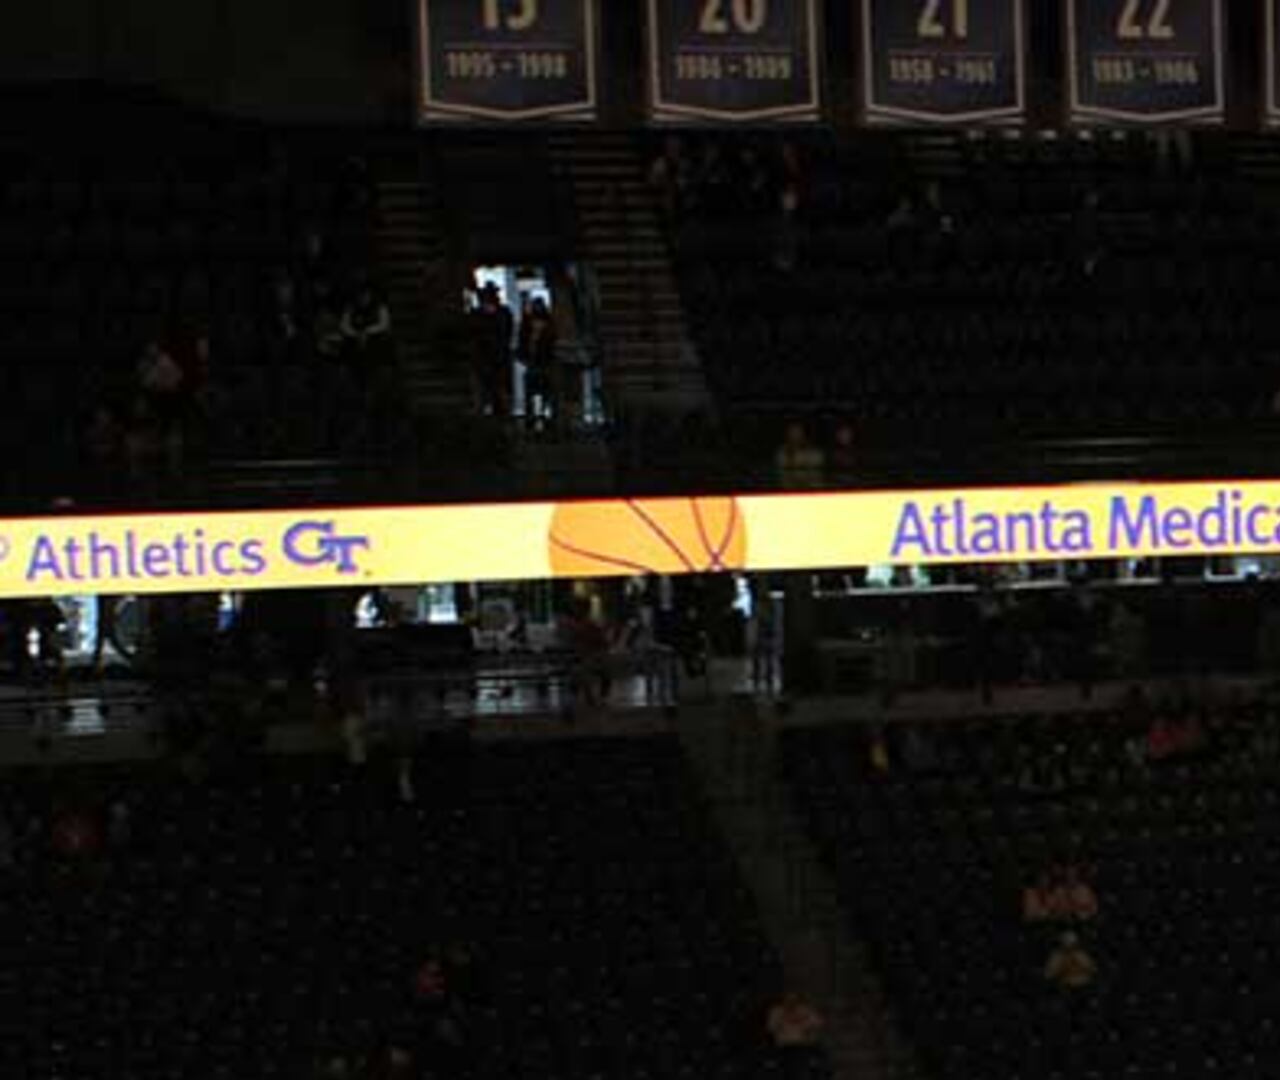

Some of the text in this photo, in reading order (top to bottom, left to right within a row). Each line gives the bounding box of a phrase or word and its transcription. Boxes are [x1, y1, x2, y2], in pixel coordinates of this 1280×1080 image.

[26, 529, 267, 580] Athletics
[281, 520, 369, 573] GT
[890, 500, 1093, 556] Atlanta
